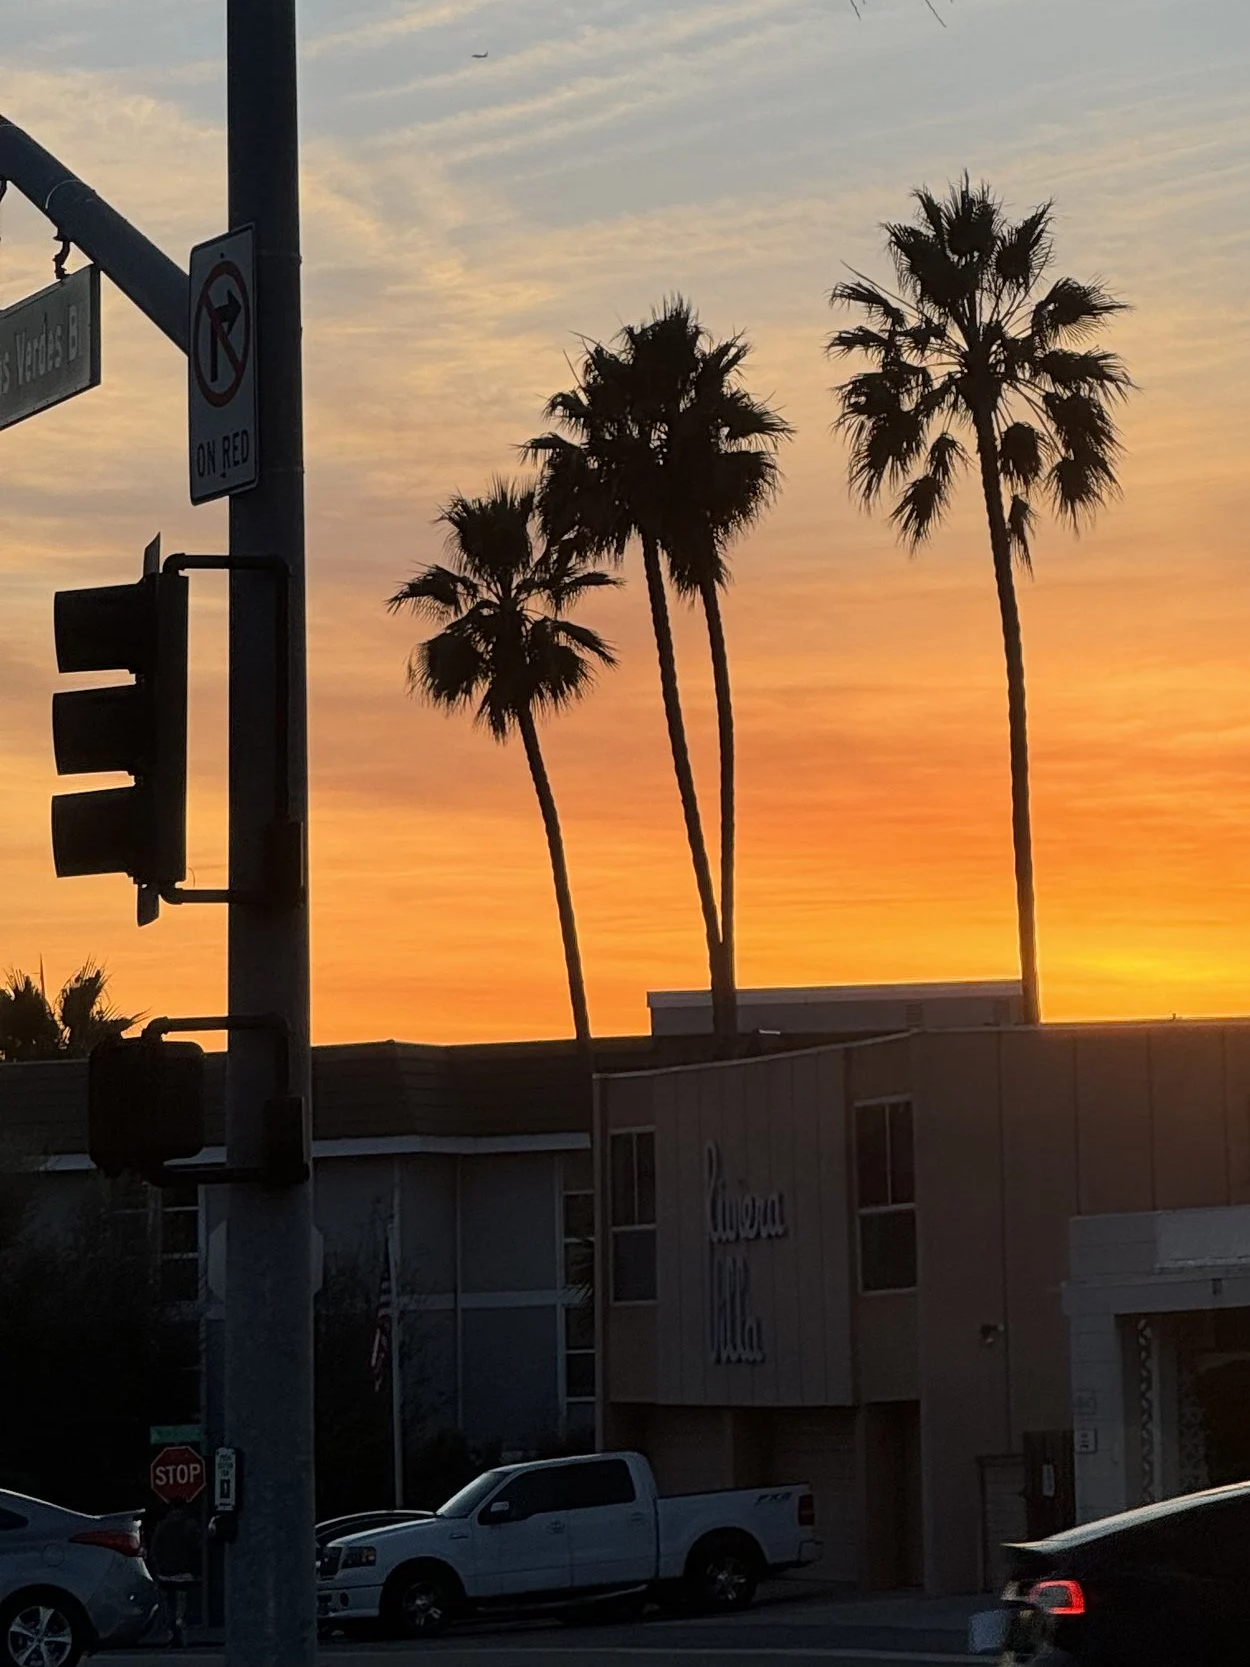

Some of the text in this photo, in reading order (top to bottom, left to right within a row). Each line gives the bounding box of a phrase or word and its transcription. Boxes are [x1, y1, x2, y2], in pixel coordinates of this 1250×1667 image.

[15, 321, 62, 386] Verdes
[197, 429, 250, 479] ON RED
[154, 1463, 202, 1486] STOP
